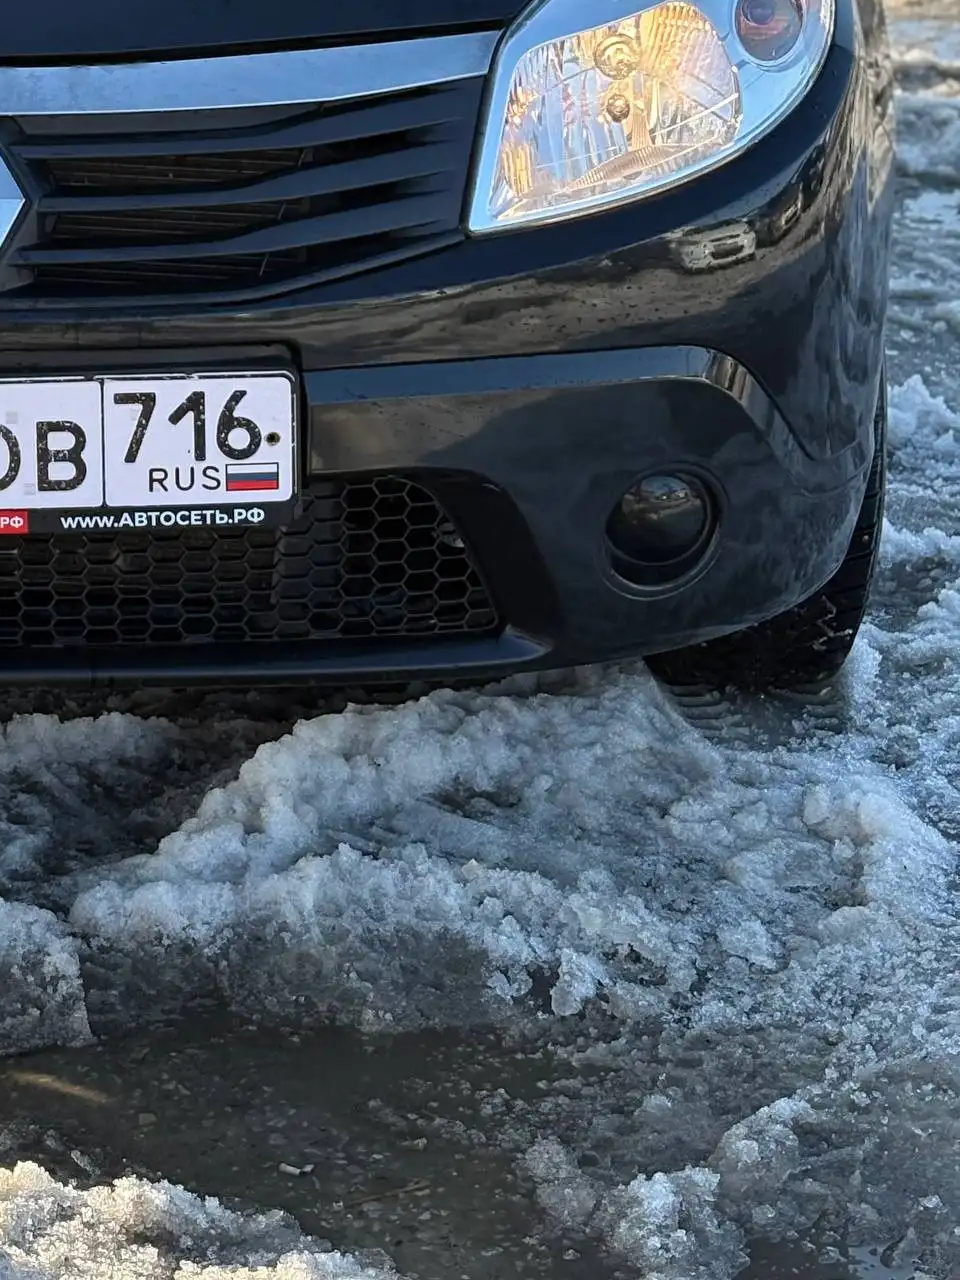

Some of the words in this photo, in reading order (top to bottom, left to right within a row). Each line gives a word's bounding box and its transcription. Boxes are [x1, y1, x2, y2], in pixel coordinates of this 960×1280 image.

[112, 389, 262, 464] 716
[148, 465, 222, 493] RUS
[0, 515, 24, 529] РФ
